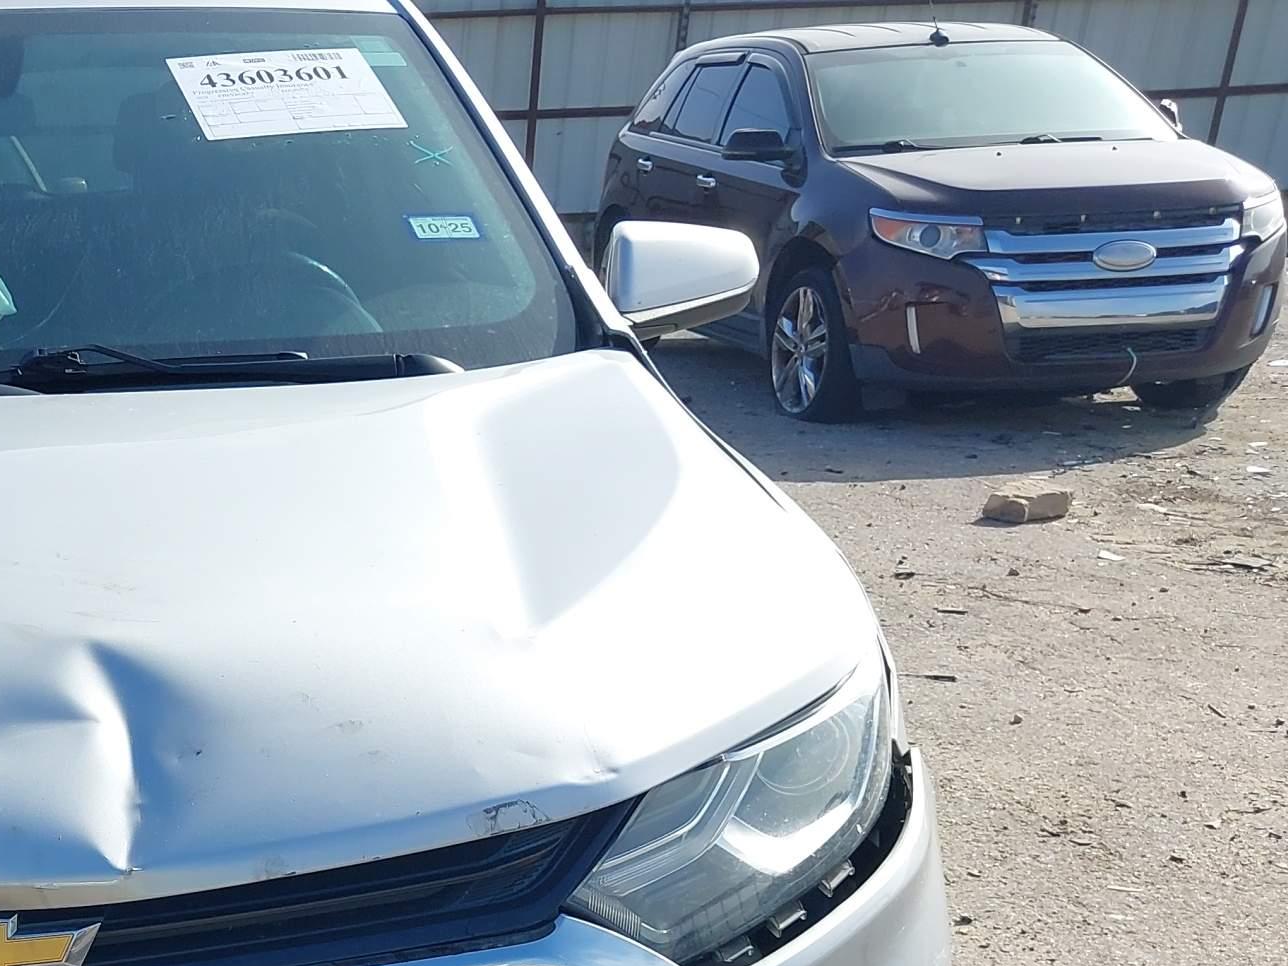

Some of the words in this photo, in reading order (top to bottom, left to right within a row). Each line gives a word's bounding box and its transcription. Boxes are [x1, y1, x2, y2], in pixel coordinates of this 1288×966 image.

[199, 65, 349, 88] 43603601
[416, 223, 440, 234] 10
[447, 222, 473, 233] 25
